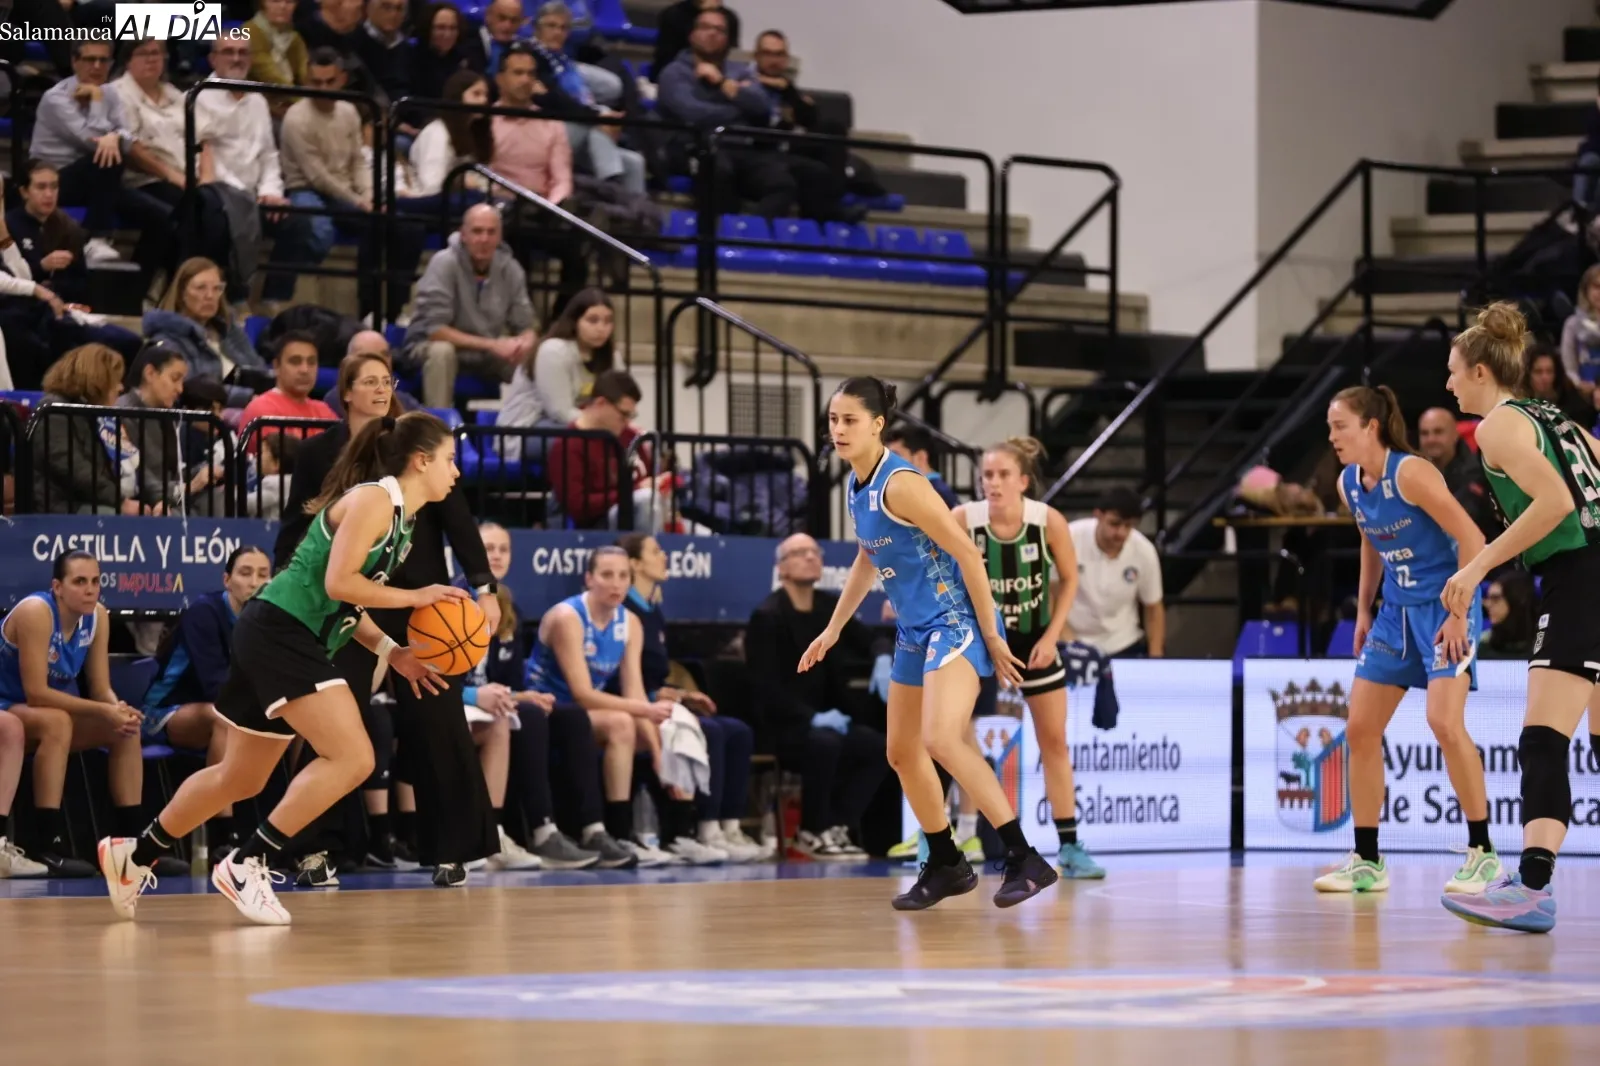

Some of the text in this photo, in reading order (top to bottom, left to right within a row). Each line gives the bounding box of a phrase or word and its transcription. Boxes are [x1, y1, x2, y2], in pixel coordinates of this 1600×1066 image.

[32, 527, 241, 569] CASTILLA Y LEÓN
[871, 535, 893, 548] LEÓN
[664, 542, 712, 578] EÓN
[101, 572, 184, 597] OS IMPULSA
[989, 572, 1043, 594] RIFOLS
[1036, 732, 1181, 772] untamiento
[1074, 784, 1180, 825] Salamanca
